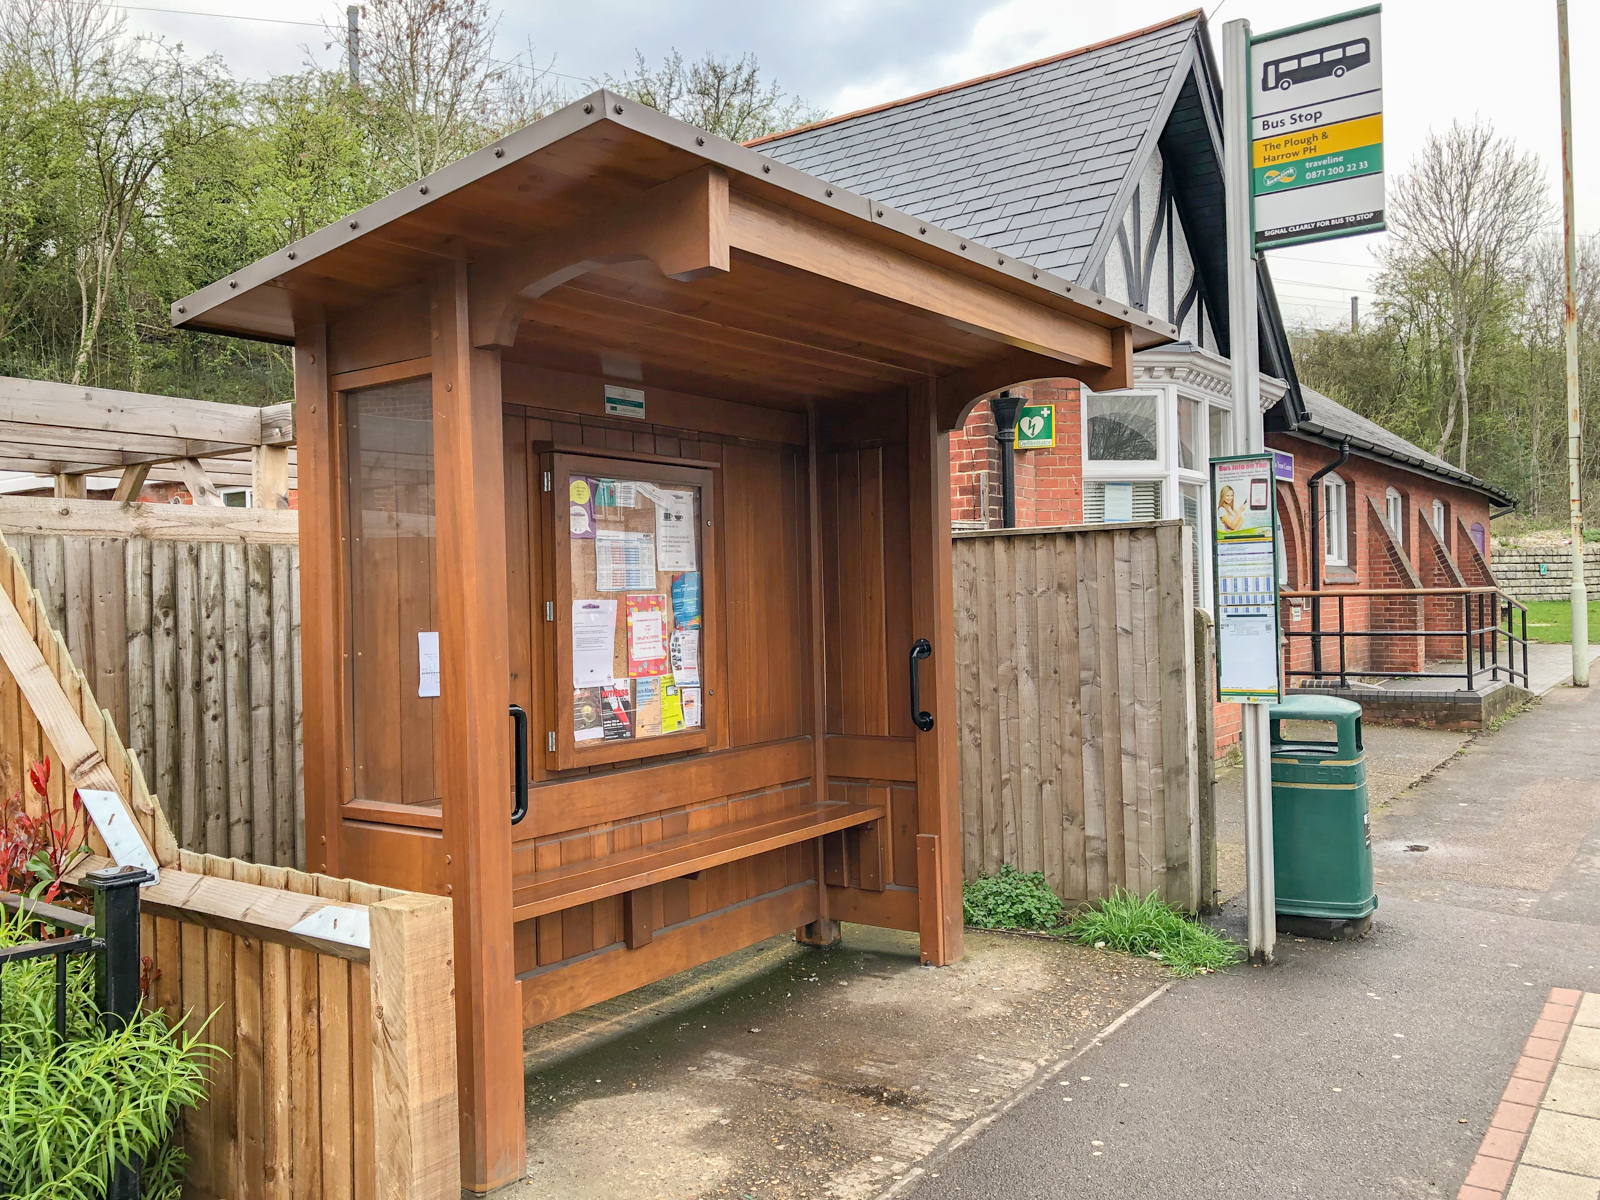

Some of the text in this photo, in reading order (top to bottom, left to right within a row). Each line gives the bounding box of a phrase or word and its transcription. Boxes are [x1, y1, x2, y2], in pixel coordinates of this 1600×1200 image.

[1262, 111, 1323, 131] Bus Stop
[1263, 131, 1329, 152] The Plough &
[1263, 145, 1317, 163] Harrow PH
[1305, 156, 1344, 168] traveline
[1305, 160, 1369, 180] 0871 200 22 33
[1264, 212, 1374, 237] SIGNAL CLEARLY FOR BUS TO STOP
[601, 689, 629, 698] WITNESS
